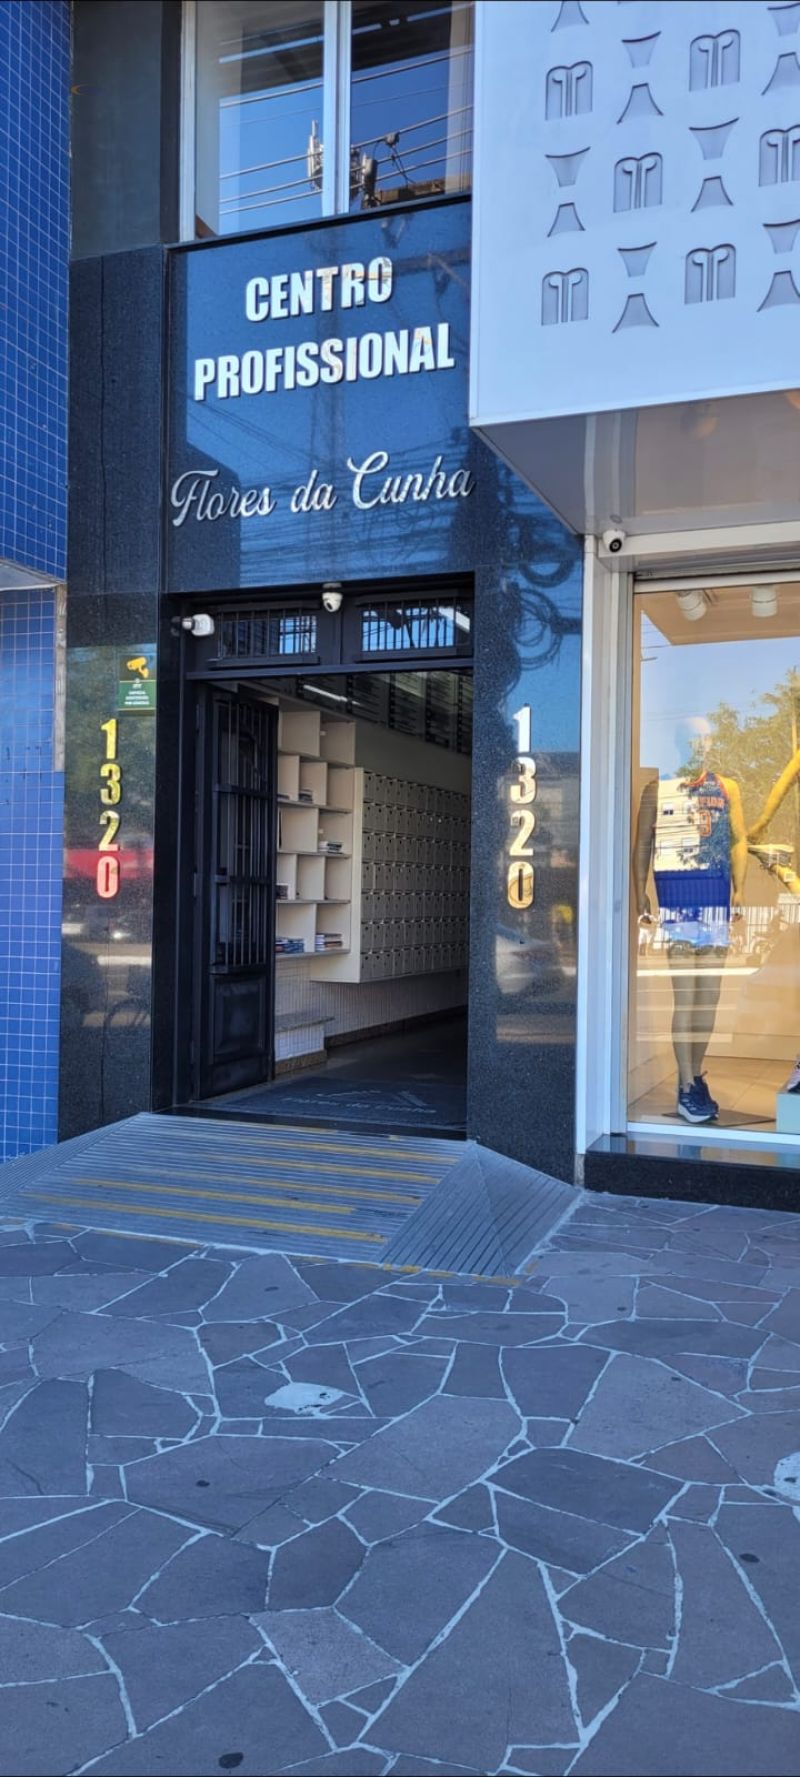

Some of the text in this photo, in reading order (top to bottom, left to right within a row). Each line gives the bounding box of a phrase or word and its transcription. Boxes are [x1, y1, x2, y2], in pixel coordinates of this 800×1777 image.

[246, 256, 393, 322] CENTRO
[194, 323, 455, 401] PROFISSIONAL
[171, 451, 474, 527] Flores da Cunha
[97, 718, 121, 898] 1320
[508, 706, 536, 909] 1320
